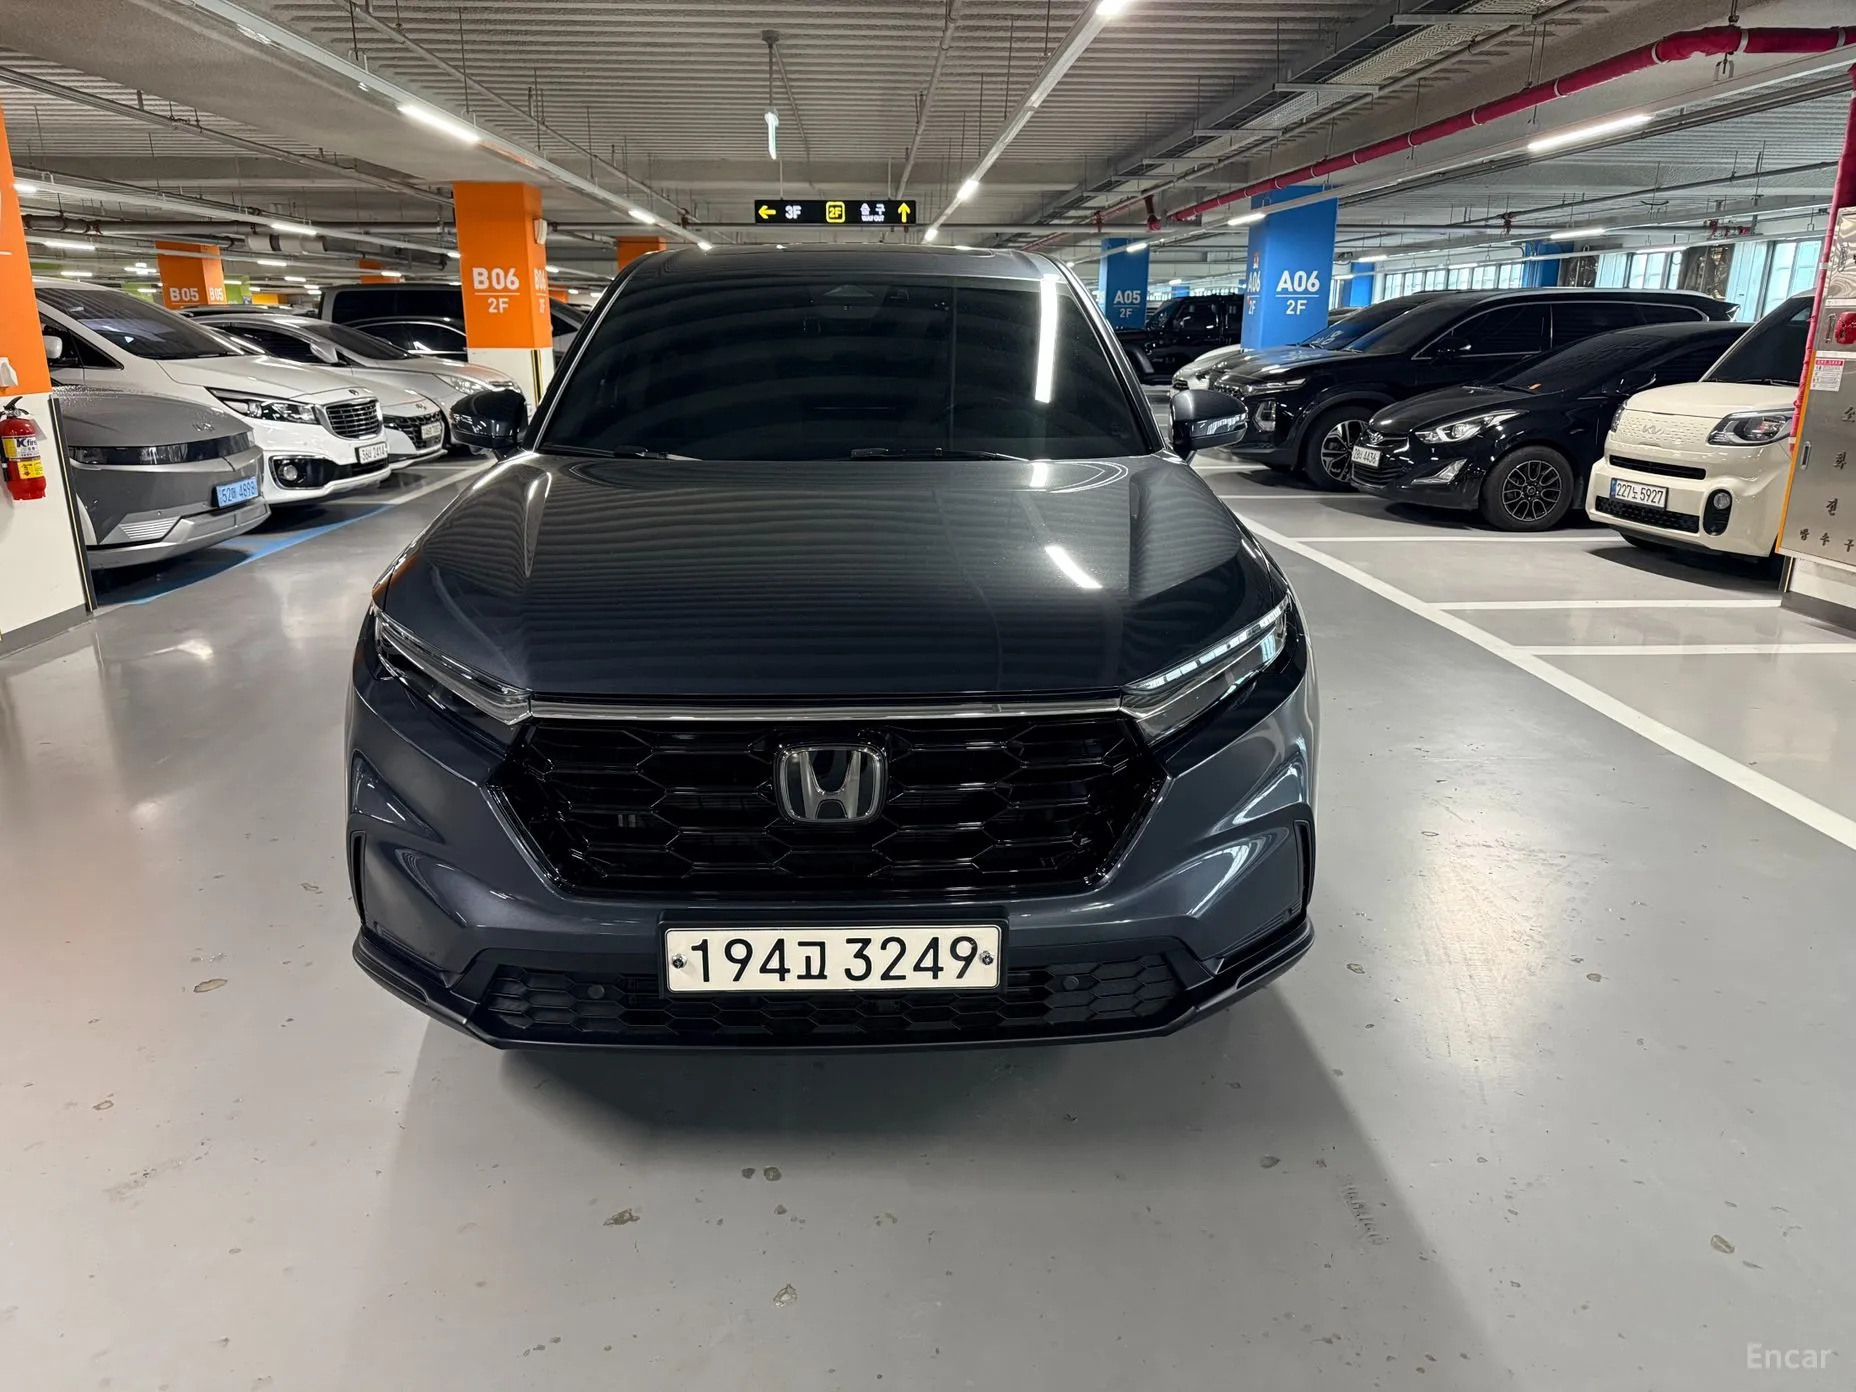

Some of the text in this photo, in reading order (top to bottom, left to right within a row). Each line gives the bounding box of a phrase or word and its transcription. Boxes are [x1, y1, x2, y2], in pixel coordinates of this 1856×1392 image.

[785, 205, 802, 220] 3F
[828, 207, 843, 218] 2F
[472, 267, 520, 290] B06
[1275, 270, 1320, 292] A06
[169, 287, 200, 301] B05
[208, 287, 224, 302] B05
[1113, 290, 1141, 304] A05
[487, 297, 509, 314] 2F
[1119, 308, 1133, 318] 2F
[1285, 299, 1307, 315] 2F
[1616, 482, 1664, 504] 227노 5927
[691, 936, 979, 982] 194고 3249
